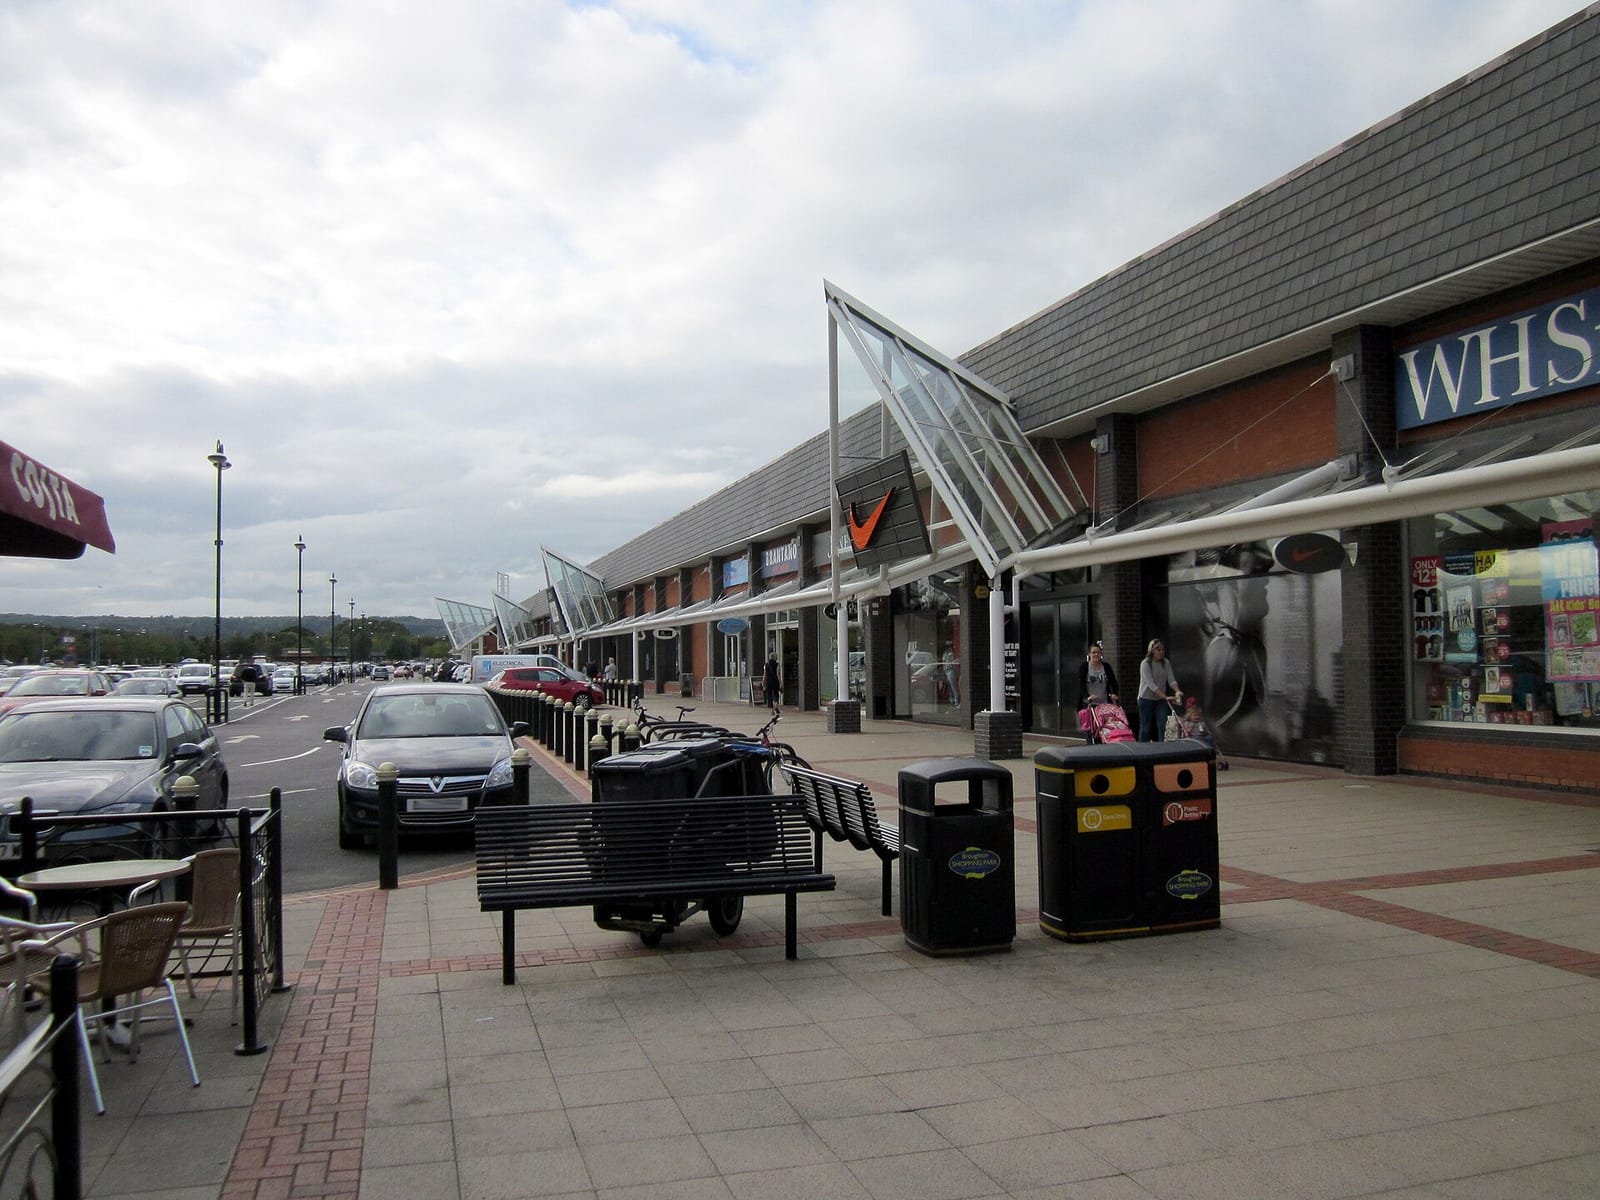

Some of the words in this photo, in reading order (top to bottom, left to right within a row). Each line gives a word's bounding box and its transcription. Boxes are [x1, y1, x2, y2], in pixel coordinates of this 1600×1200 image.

[1400, 299, 1600, 420] WHS
[10, 452, 81, 525] COSTA
[765, 543, 797, 566] BRANTANO
[1414, 559, 1437, 569] ONLY
